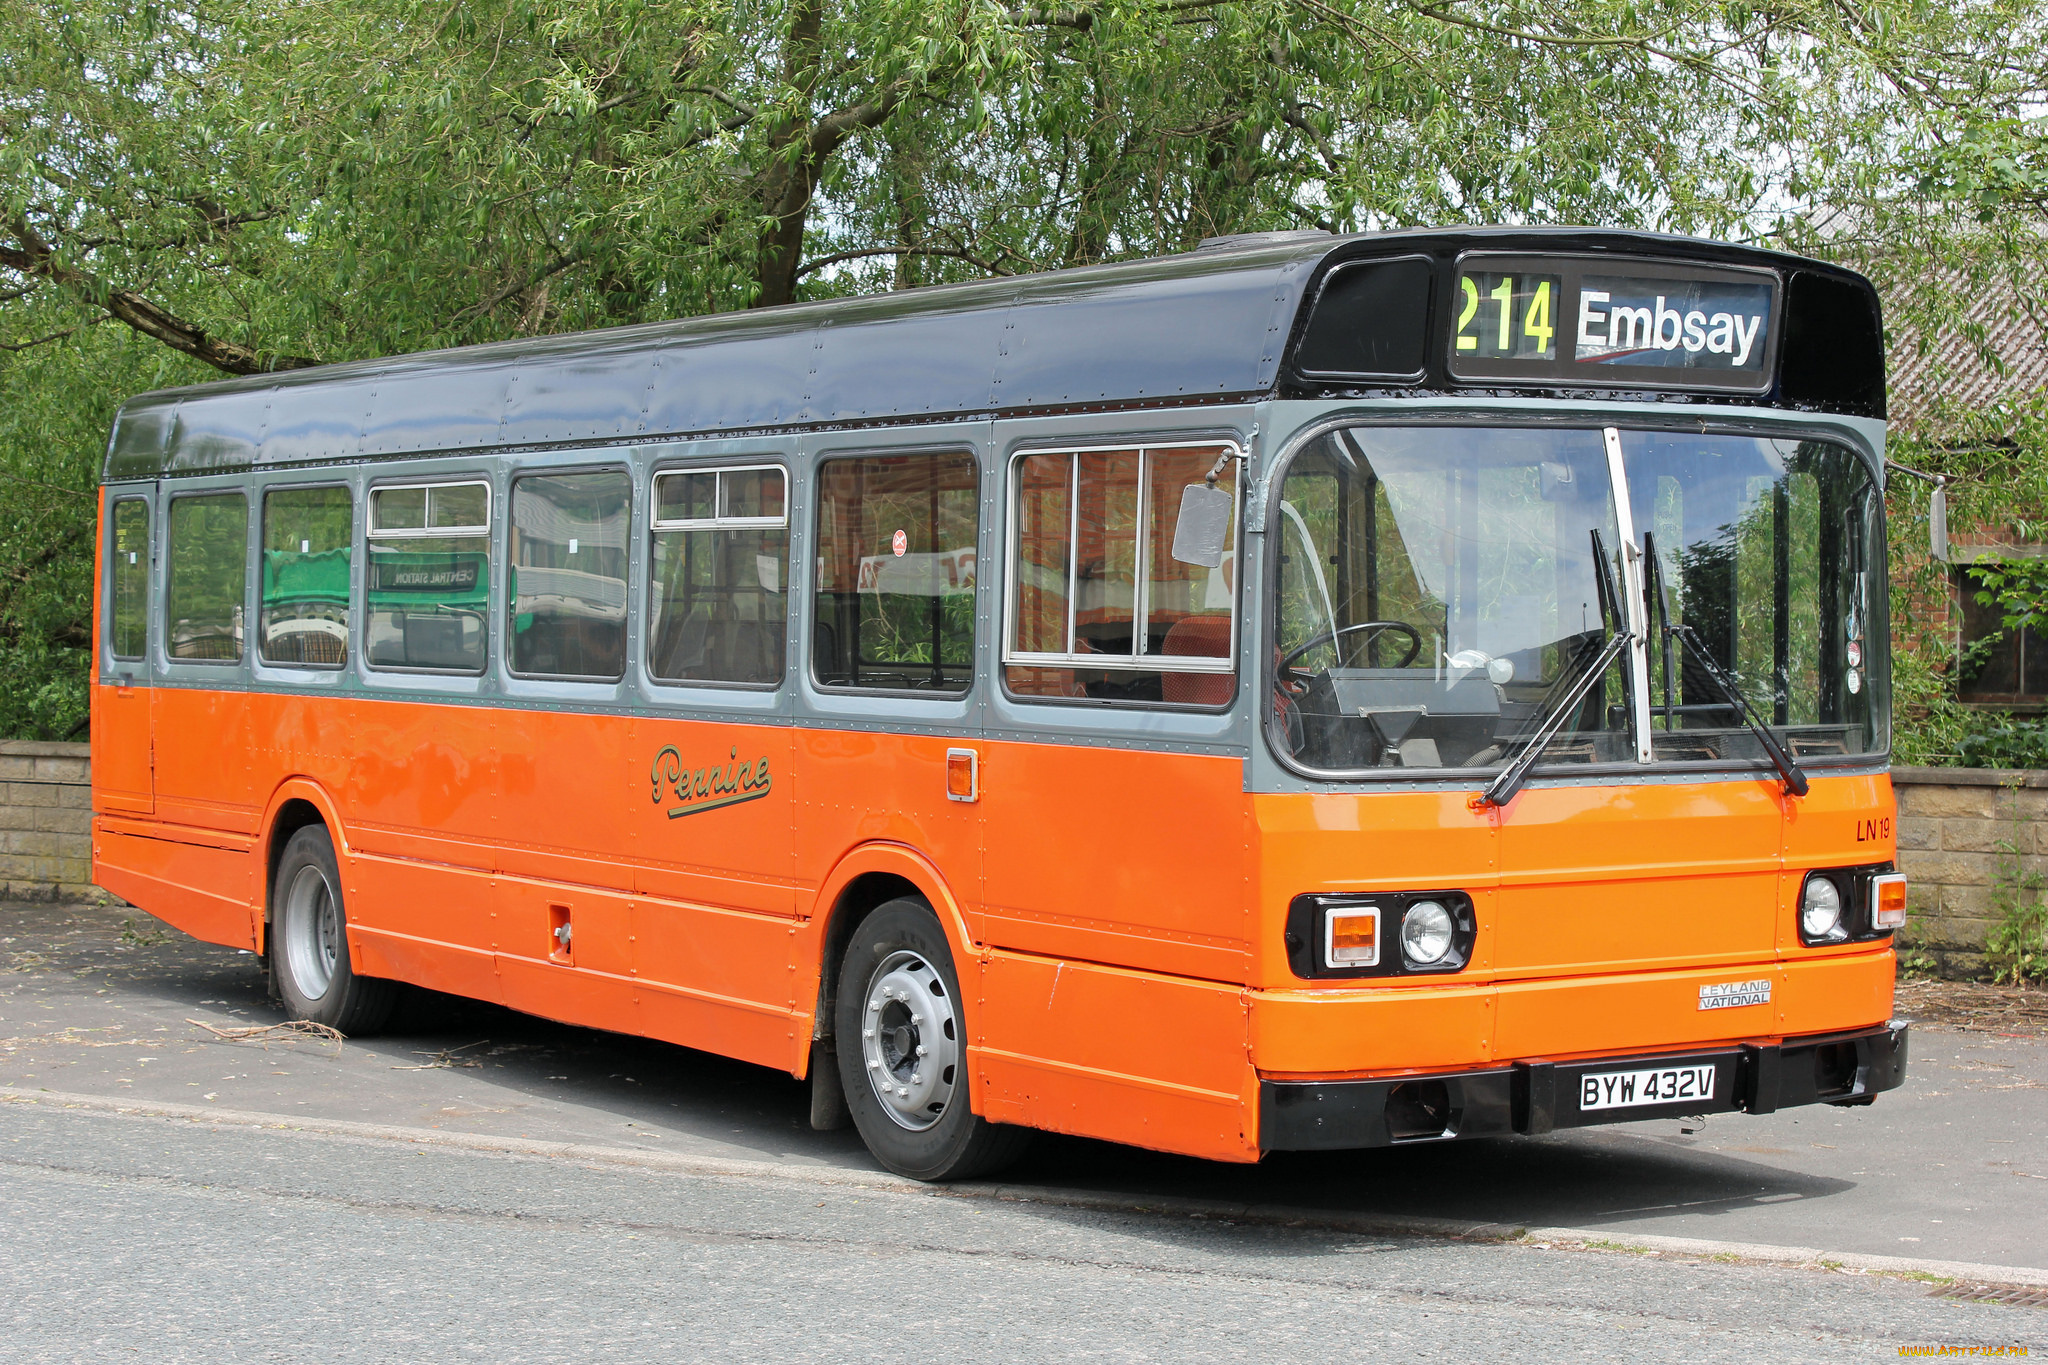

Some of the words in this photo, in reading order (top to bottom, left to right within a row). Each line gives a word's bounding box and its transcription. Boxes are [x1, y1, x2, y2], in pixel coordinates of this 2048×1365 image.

[1456, 276, 1553, 354] 214
[1577, 291, 1761, 367] Embsay
[651, 744, 772, 819] Pennine
[1857, 819, 1876, 841] LN
[1880, 817, 1890, 839] 19
[1699, 993, 1769, 1009] NATIONAL
[1701, 980, 1770, 996] LEYLAND
[1583, 1075, 1636, 1106] BYW
[1643, 1069, 1712, 1100] 432V
